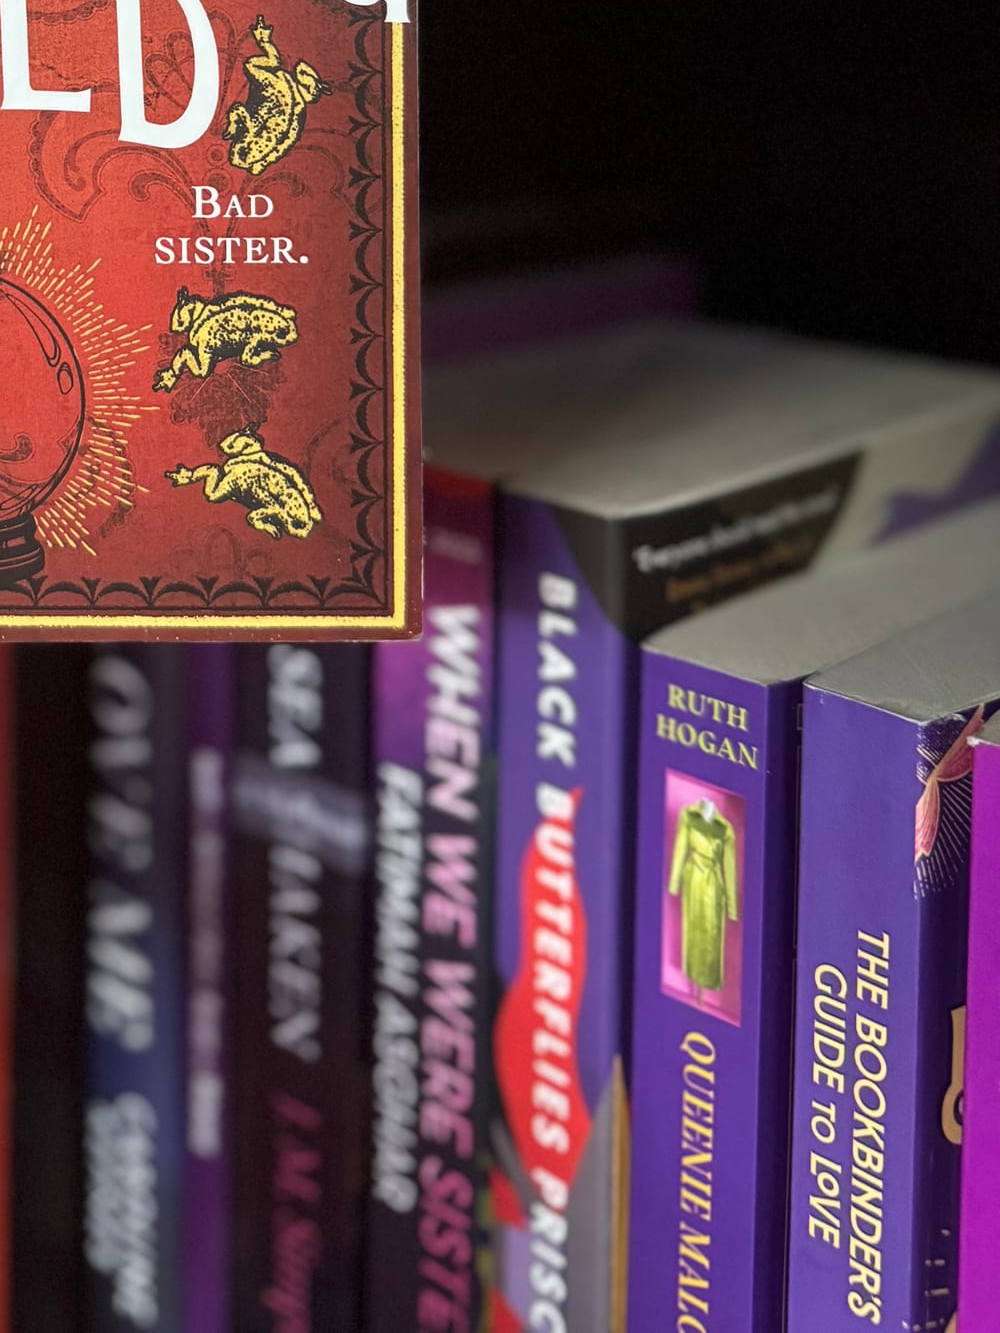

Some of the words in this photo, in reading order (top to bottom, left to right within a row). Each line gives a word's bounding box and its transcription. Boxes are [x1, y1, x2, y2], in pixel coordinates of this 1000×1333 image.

[154, 229, 310, 265] SISTER.
[191, 185, 274, 220] BAD
[424, 603, 483, 824] WHEN
[535, 570, 579, 769] BLACK
[666, 683, 749, 732] RUTH
[656, 714, 759, 771] HOGAN
[420, 830, 479, 949] WE
[530, 781, 578, 1155] BUTTERFLIES
[857, 929, 890, 1011] THE
[416, 958, 476, 1160] WERE
[813, 963, 848, 1094] GUIDE
[678, 1030, 717, 1223] QUEENIE
[811, 1096, 844, 1145] TO
[847, 1017, 888, 1326] BOOKBINDER'S
[809, 1150, 843, 1249] LOVE
